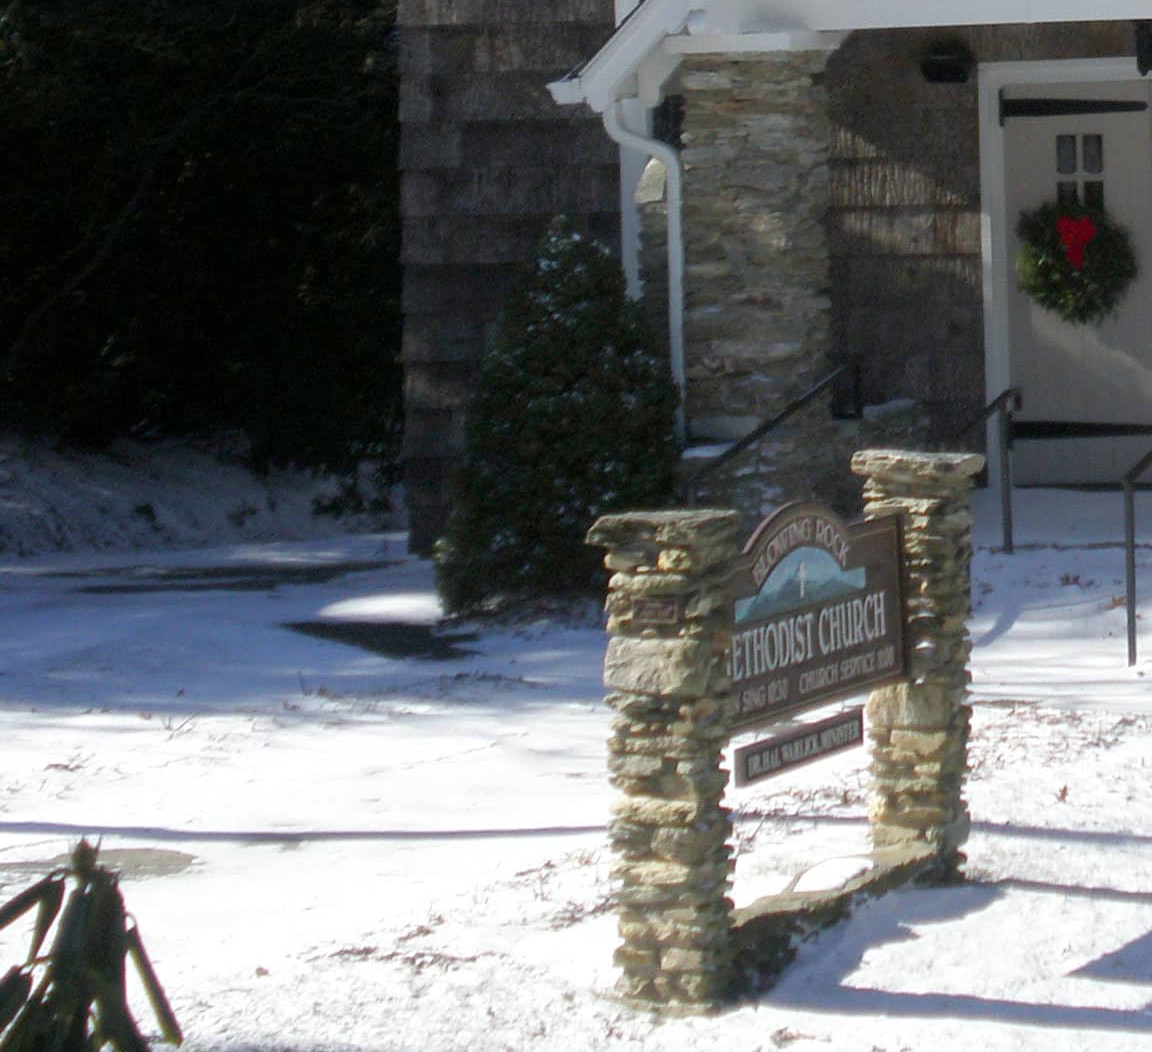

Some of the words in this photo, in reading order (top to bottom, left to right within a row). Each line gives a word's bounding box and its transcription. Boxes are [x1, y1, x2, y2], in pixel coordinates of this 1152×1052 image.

[752, 518, 811, 586] BLOWING
[815, 518, 849, 567] ROCK
[725, 612, 814, 682] ETHODIST
[818, 591, 887, 654] CHURCH
[800, 662, 839, 695] CHURCH
